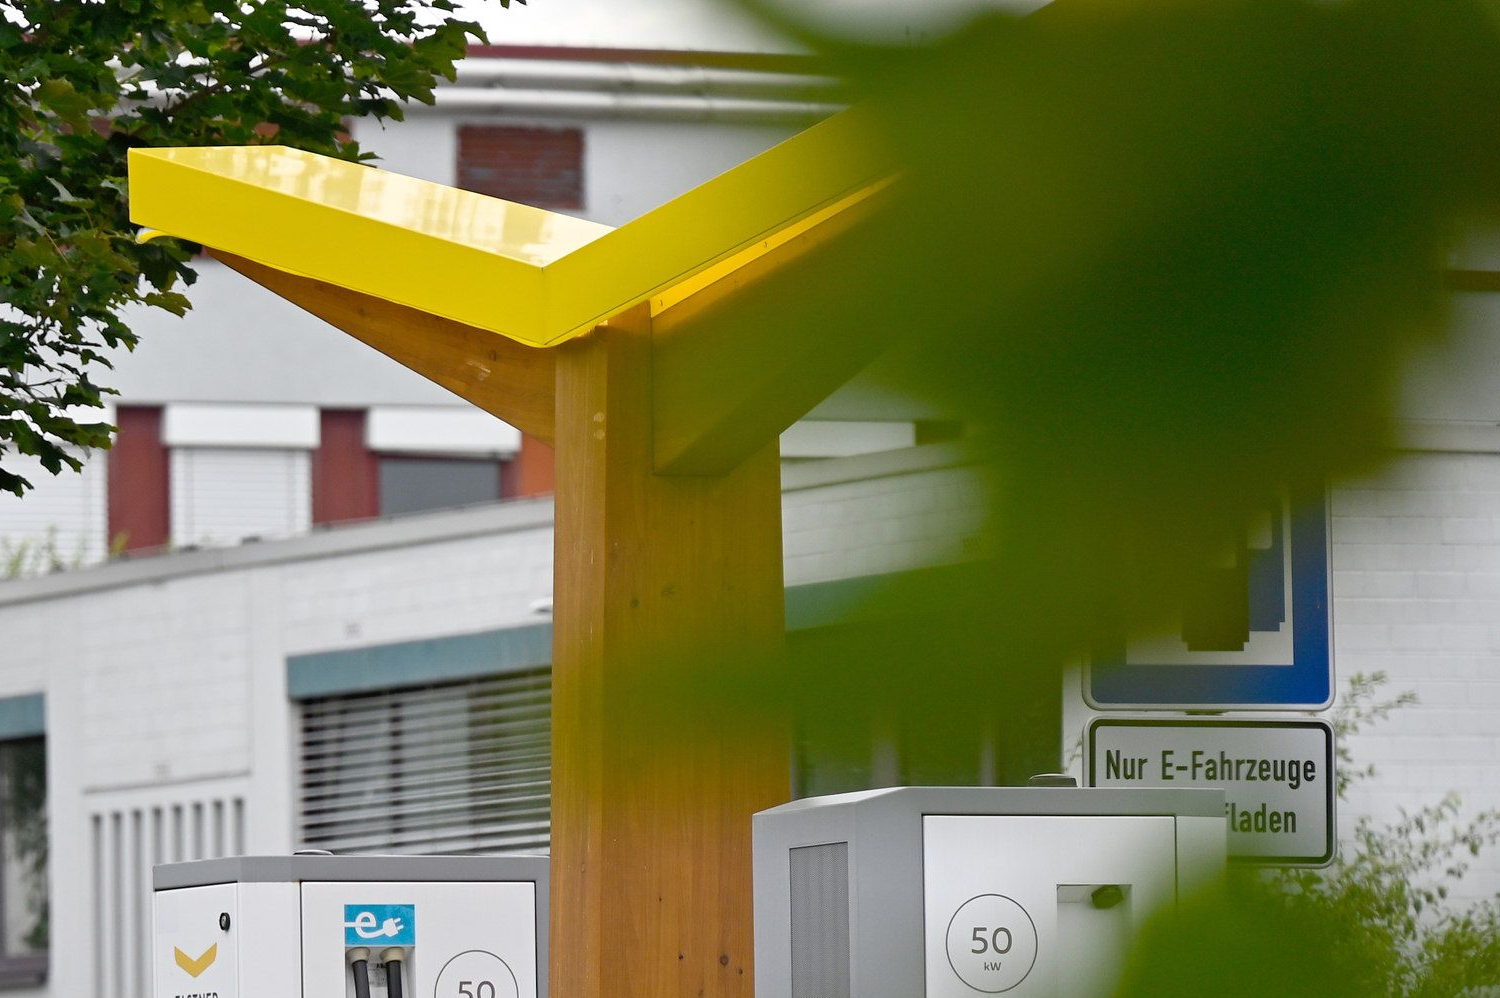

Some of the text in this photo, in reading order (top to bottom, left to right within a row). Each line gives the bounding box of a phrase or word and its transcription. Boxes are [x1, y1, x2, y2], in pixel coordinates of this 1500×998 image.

[1106, 750, 1316, 790] Nur E-Fahrzeuge
[971, 927, 1013, 955] 50
[984, 962, 1002, 971] kW
